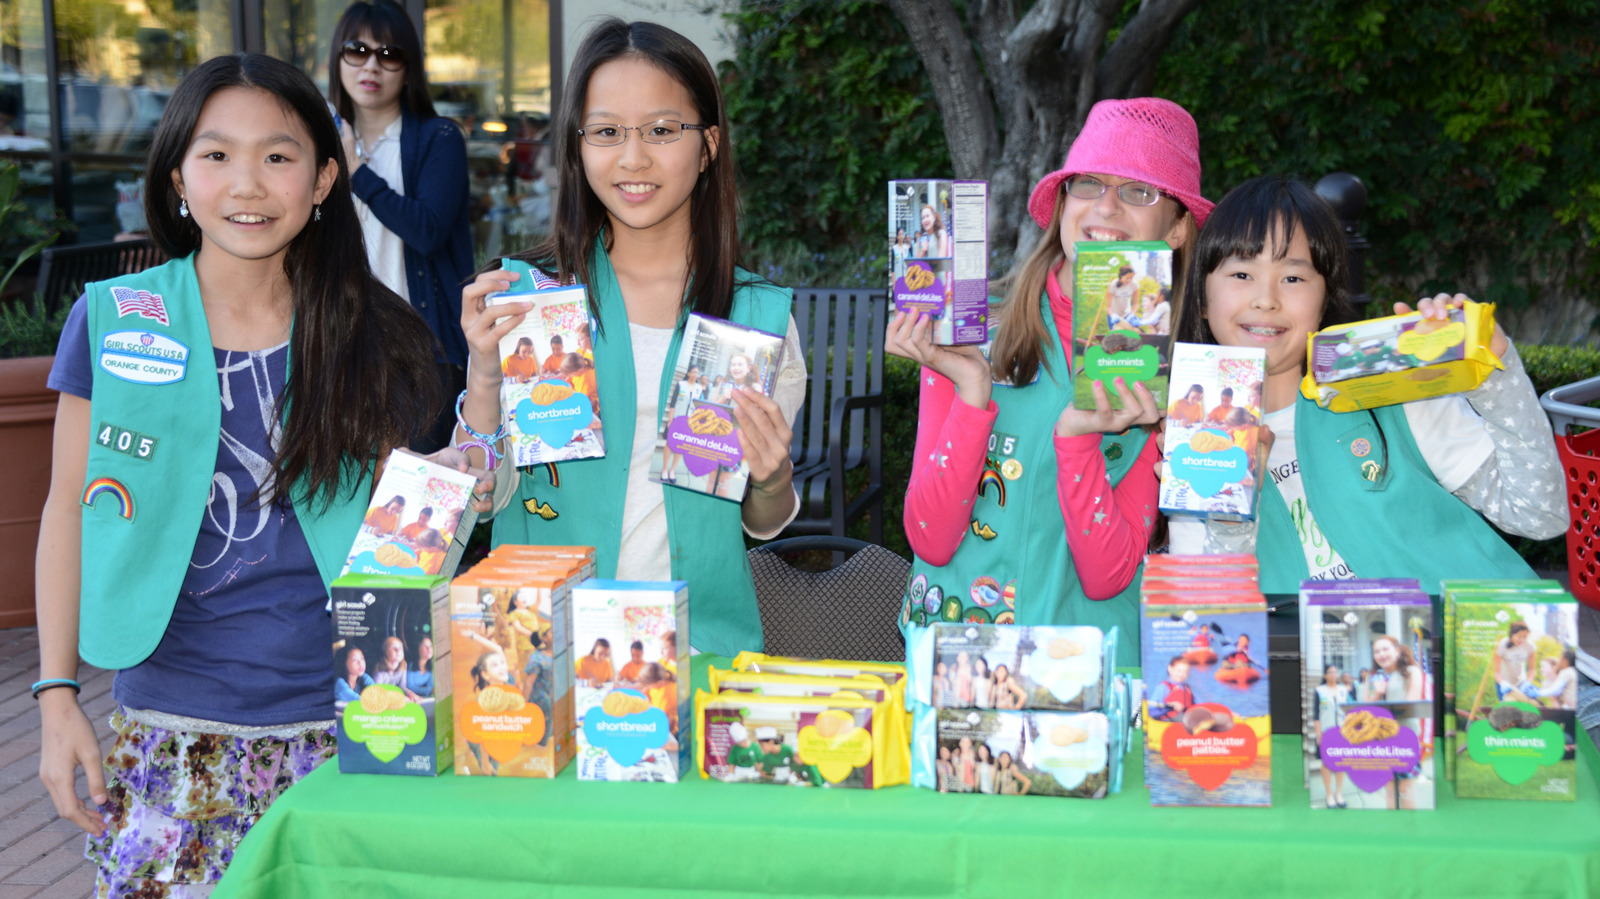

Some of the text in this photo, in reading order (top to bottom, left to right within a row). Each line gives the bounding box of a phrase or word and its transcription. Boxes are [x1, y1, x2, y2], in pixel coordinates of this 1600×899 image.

[106, 340, 184, 360] GIRL SCOUTS USA
[105, 359, 179, 377] ORANGE COUNTY
[1097, 357, 1116, 366] thin
[528, 406, 581, 420] shortbread
[99, 426, 153, 457] 405
[672, 432, 708, 448] caramel
[1181, 456, 1236, 469] shortbread
[352, 714, 381, 724] mango
[472, 713, 532, 724] peanut butter
[482, 723, 523, 732] sandwich
[596, 721, 657, 733] shortbread
[1176, 736, 1245, 749] peanut butter
[1484, 735, 1545, 749] thin mints
[1326, 745, 1370, 757] caramel
